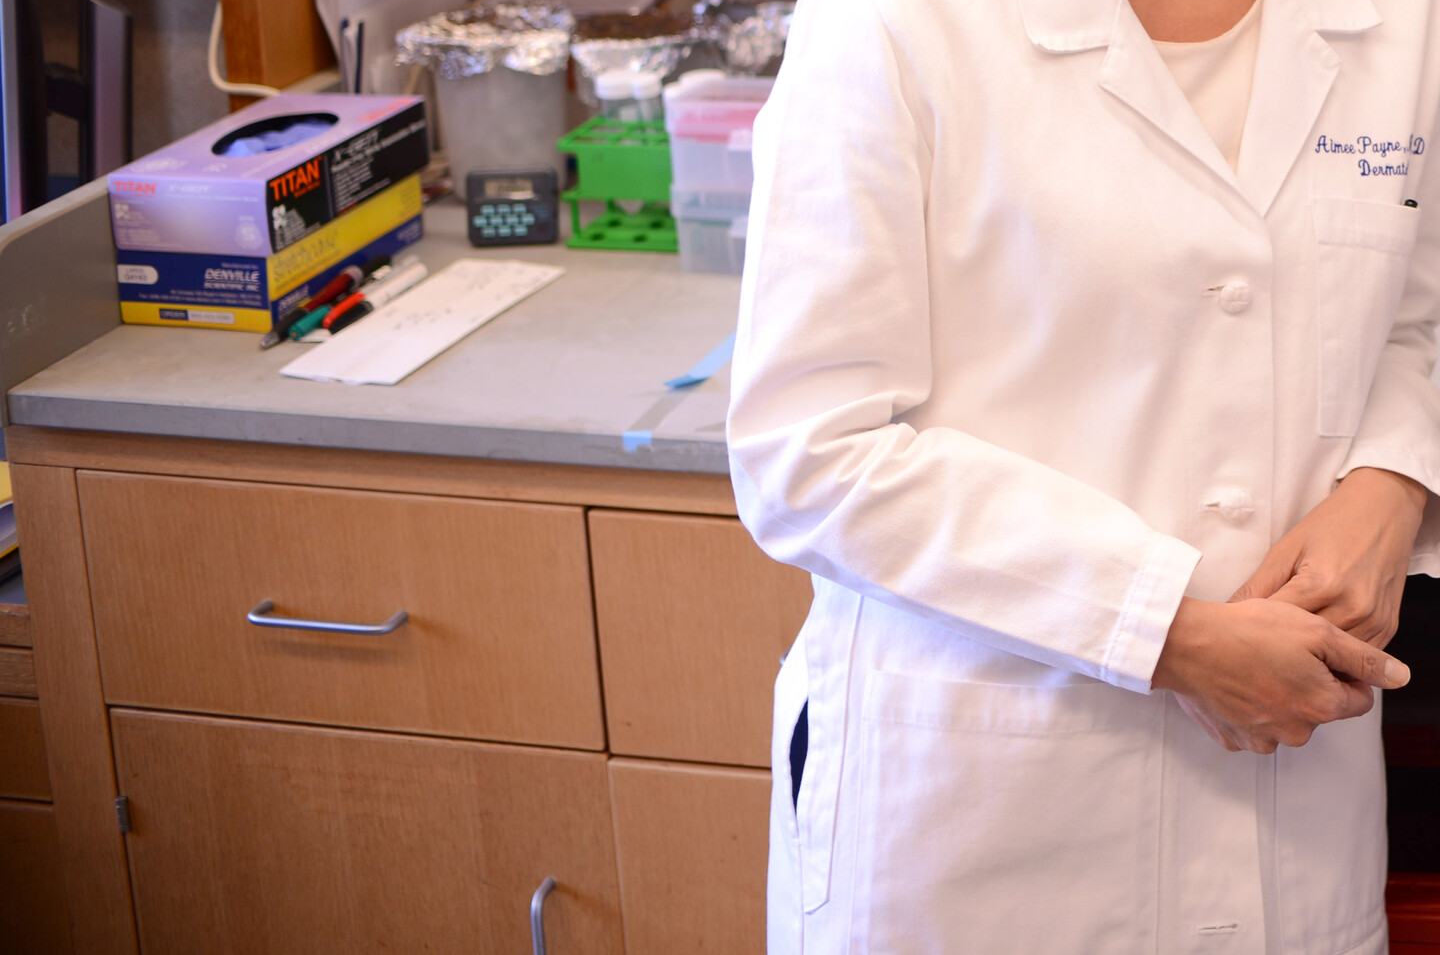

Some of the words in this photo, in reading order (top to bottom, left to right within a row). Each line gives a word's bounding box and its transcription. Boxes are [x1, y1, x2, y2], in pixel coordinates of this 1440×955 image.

[1315, 135, 1356, 154] Aimee
[269, 155, 323, 201] TITAN
[113, 181, 157, 194] TITAN
[204, 268, 261, 281] DENVILLE
